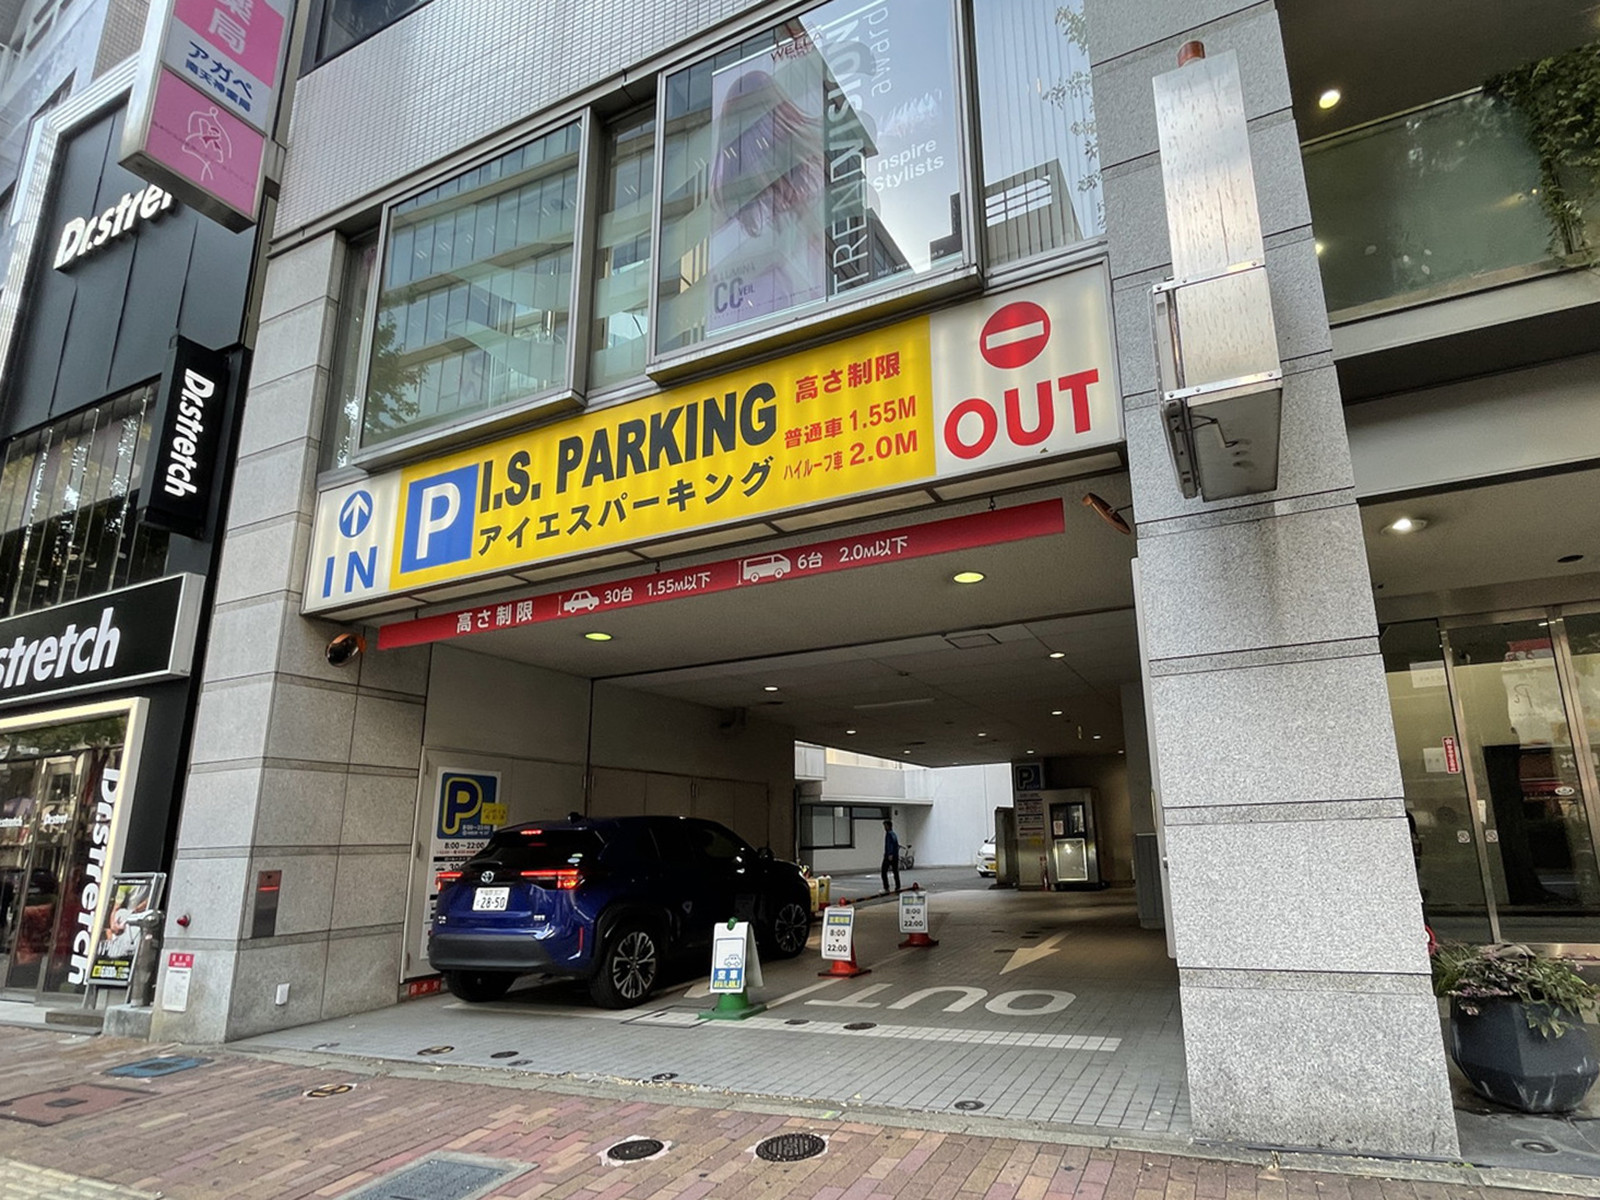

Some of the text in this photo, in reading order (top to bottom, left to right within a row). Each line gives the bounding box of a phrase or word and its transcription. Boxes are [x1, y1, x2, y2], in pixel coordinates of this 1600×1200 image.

[873, 155, 944, 192] Stylists
[714, 277, 744, 314] CC
[738, 284, 756, 297] VEIL
[795, 351, 900, 404] 高さ制限
[165, 368, 215, 497] Dr.stretch
[784, 396, 916, 450] 普通車 1.55M
[944, 368, 1100, 461] OUT
[480, 382, 777, 514] I.S. PARKING
[784, 429, 918, 481] ハイルーフ車 2.0M
[415, 482, 461, 561] P
[478, 455, 774, 557] アイエスパーキング
[322, 546, 378, 598] IN
[456, 601, 533, 634] 高さ制限
[604, 586, 633, 605] 30台
[798, 552, 824, 570] 6台
[827, 944, 848, 952] 22:00
[829, 929, 846, 937] 8:00
[804, 983, 1076, 1016] OUT
